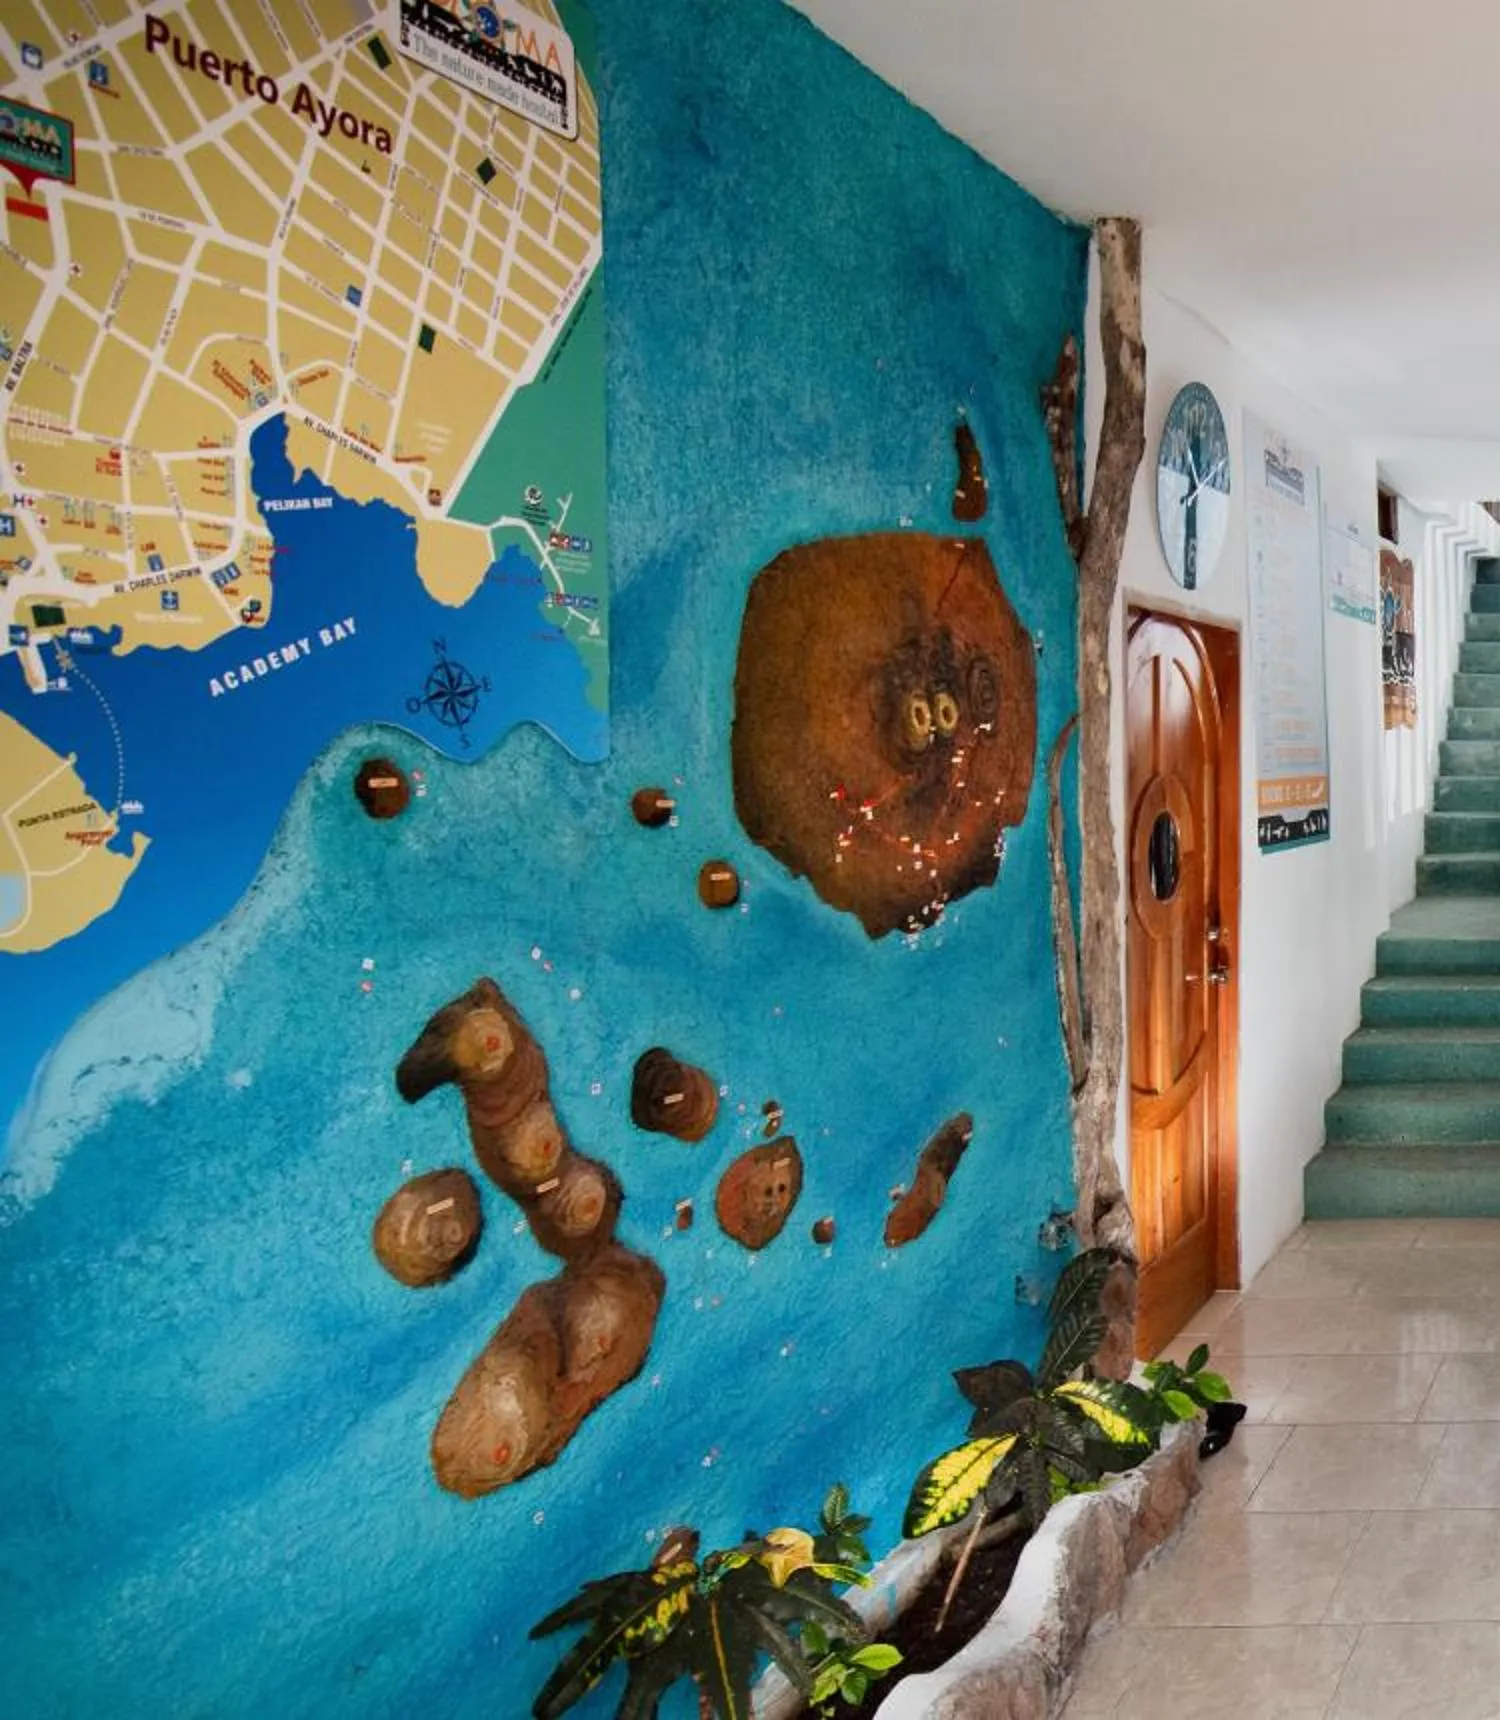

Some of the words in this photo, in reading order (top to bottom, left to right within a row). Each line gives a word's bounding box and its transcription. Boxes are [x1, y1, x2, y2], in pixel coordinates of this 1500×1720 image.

[145, 14, 279, 104] Puerto
[292, 82, 392, 155] Ayora
[209, 637, 312, 697] ACADEMY
[319, 616, 357, 648] BAY
